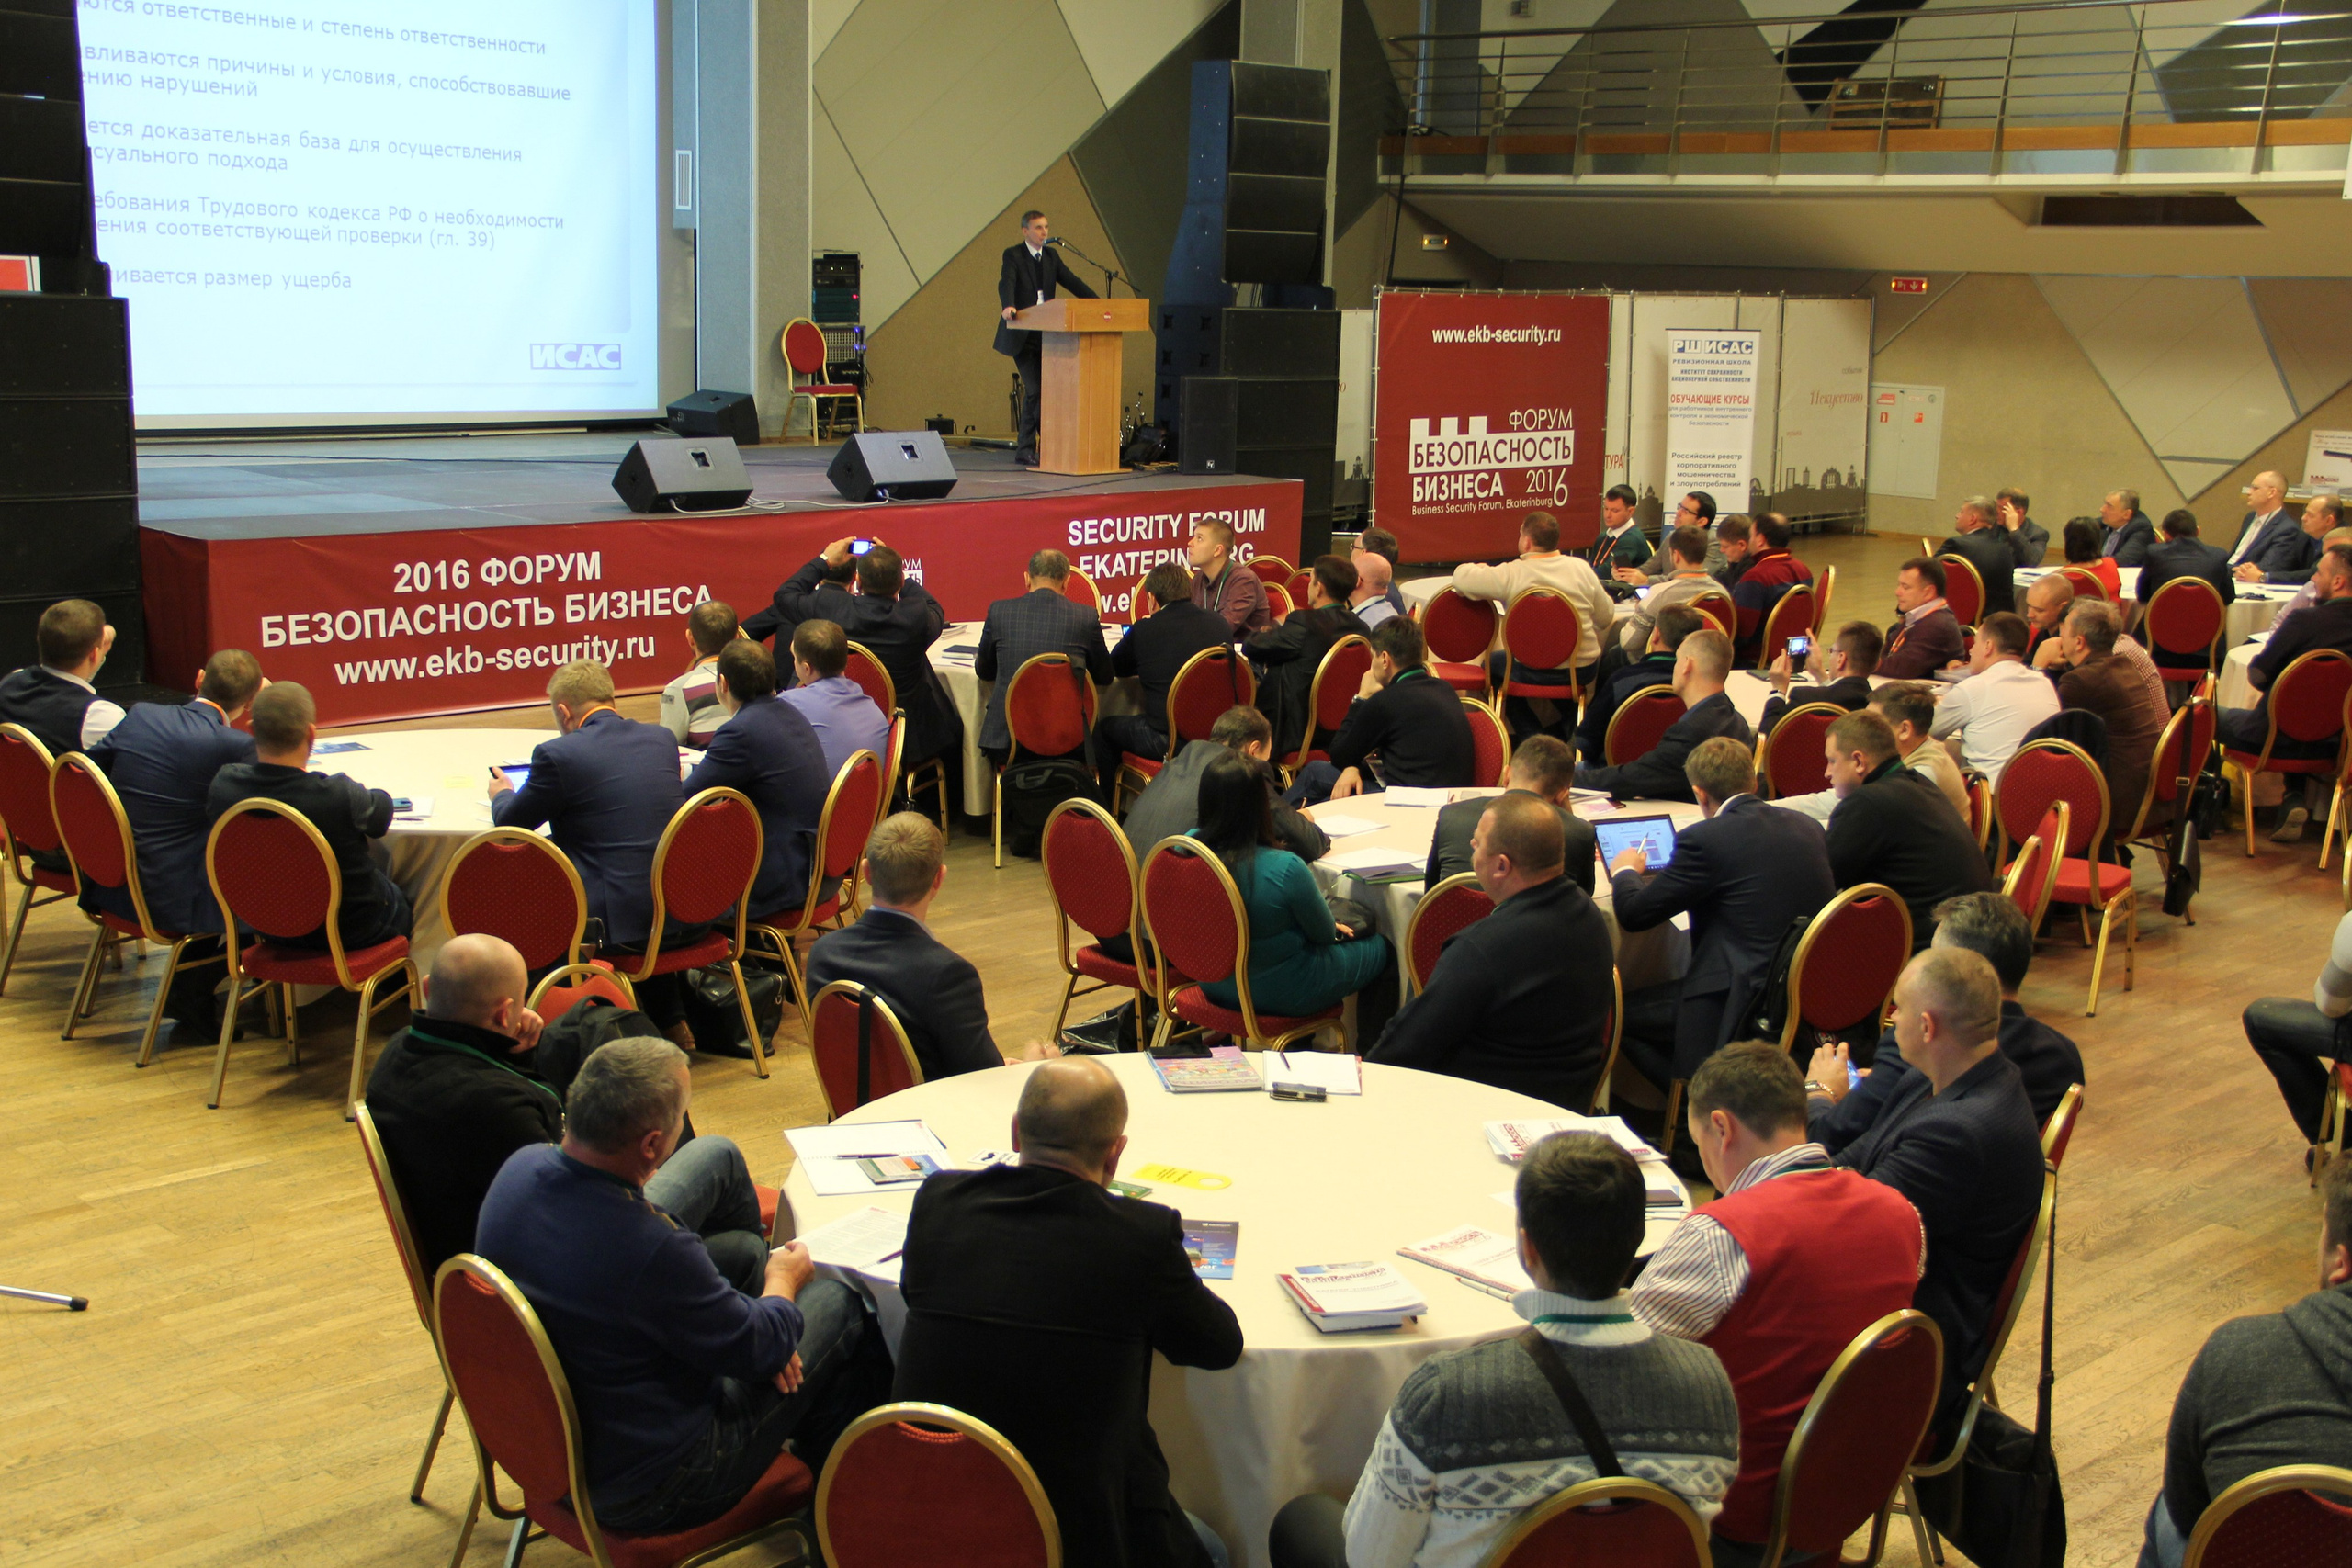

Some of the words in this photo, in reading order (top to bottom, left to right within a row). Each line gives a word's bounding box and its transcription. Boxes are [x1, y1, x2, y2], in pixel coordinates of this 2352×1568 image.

[77, 0, 135, 13] ются
[142, 2, 296, 29] ответственные
[303, 19, 313, 31] и
[322, 20, 394, 40] степень
[401, 28, 546, 54] ответственности
[82, 45, 199, 69] вливаются
[208, 57, 295, 77] причины
[303, 66, 313, 78] и
[322, 68, 401, 89] условия,
[409, 75, 571, 100] способствовавшие
[141, 74, 258, 96] нарушений
[141, 124, 290, 147] доказательная
[300, 130, 340, 150] база
[348, 139, 379, 154] для
[388, 141, 522, 163] осуществления
[208, 153, 288, 172] подхода
[198, 197, 298, 219] Трудового
[308, 206, 380, 222] кодекса
[389, 206, 412, 222] РФ
[418, 211, 428, 222] о
[435, 209, 564, 230] необходимости
[156, 222, 331, 243] соответствующей
[337, 228, 423, 247] проверки
[429, 229, 458, 250] (гл.
[468, 231, 495, 251] 39)
[111, 269, 197, 285] ивается
[204, 272, 272, 290] размер
[281, 271, 352, 291] ущерба
[1431, 324, 1562, 346] www.ekb-security.ru
[1673, 340, 1701, 354] РШ
[1704, 340, 1753, 355] ИСАС
[530, 343, 622, 371] ИСАС
[1670, 393, 1722, 406] ОБУЧАЮЩИЕ
[1724, 395, 1750, 405] КУРСЫ
[1509, 408, 1573, 431] ФОРУМ
[1413, 435, 1572, 468] БЕЗОПАСНОСТЬ
[1671, 451, 1716, 459] Российский
[1717, 453, 1743, 461] реестр
[1412, 471, 1504, 502] БИЗНЕСА
[1525, 467, 1568, 507] 2016
[1676, 479, 1742, 489] злоупотреблений
[1412, 504, 1444, 516] Business
[1445, 502, 1476, 514] Security
[1505, 496, 1553, 510] Ekaterinburg
[1068, 513, 1183, 546] SECURITY
[393, 558, 470, 593] 2016
[480, 550, 602, 587] ФОРУМ
[261, 596, 556, 649] БЕЗОПАСНОСТЬ
[565, 584, 713, 623] БИЗНЕСА
[334, 634, 656, 685] www.ekb-security.ru
